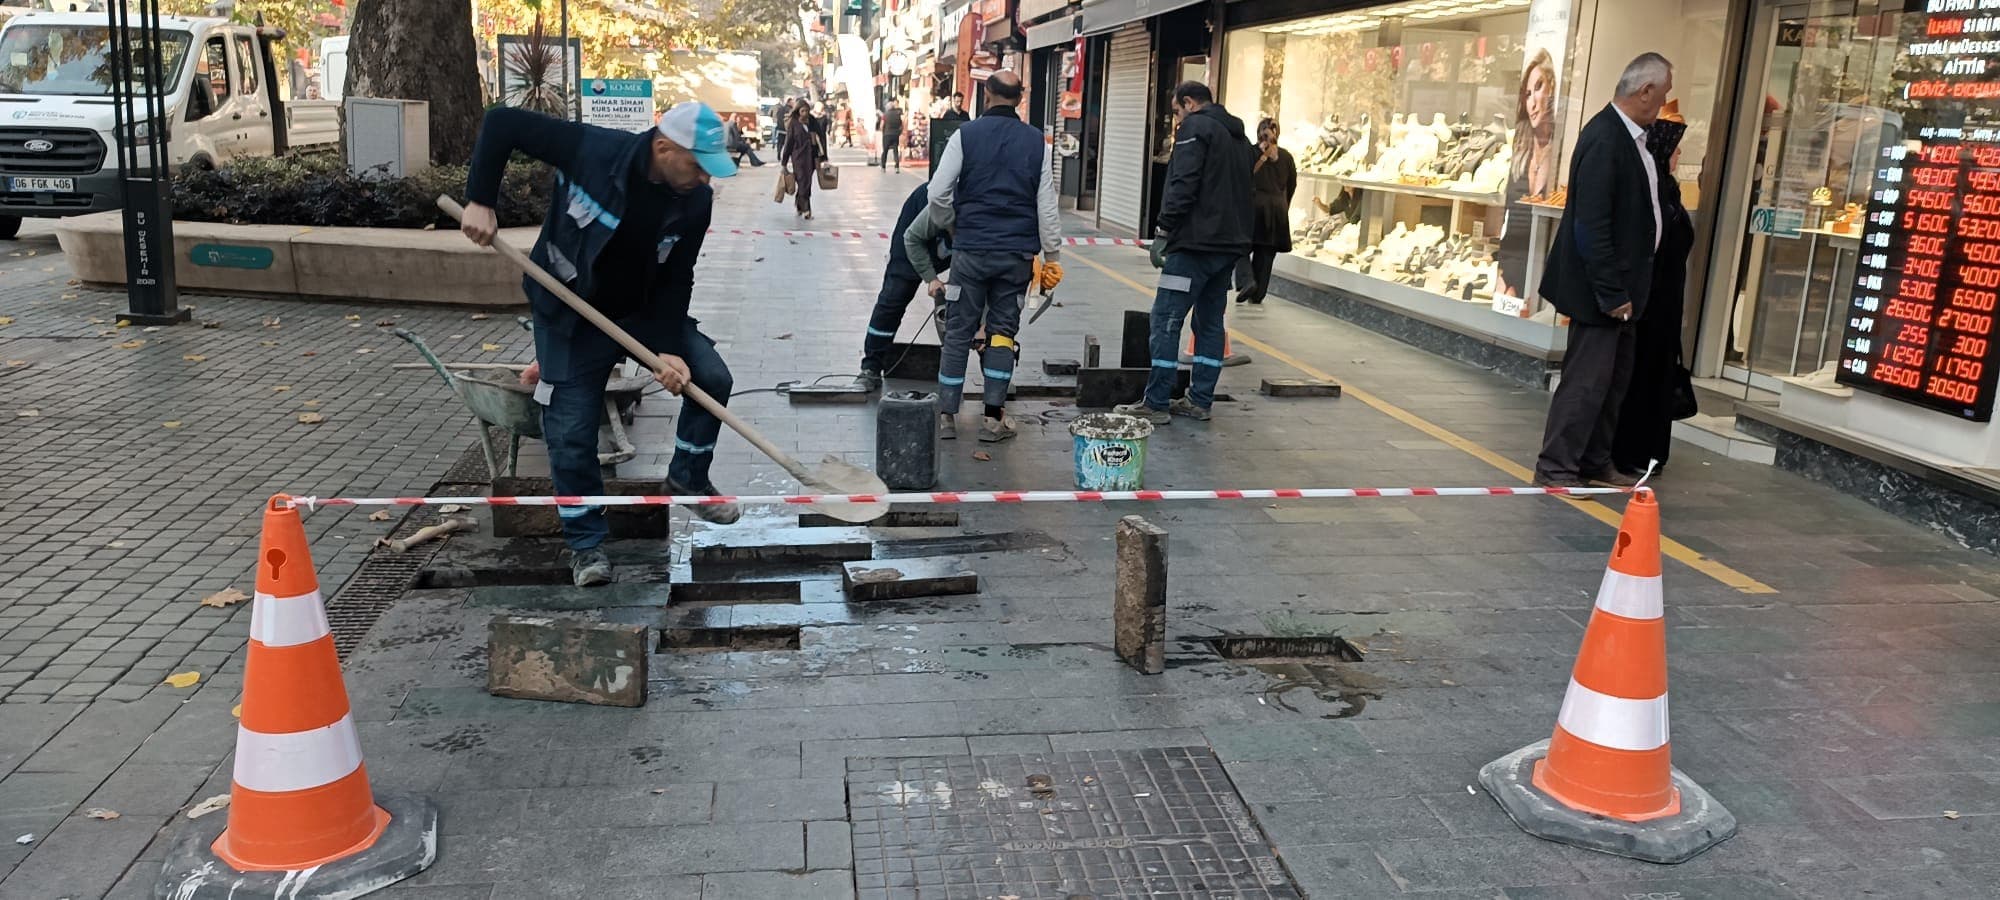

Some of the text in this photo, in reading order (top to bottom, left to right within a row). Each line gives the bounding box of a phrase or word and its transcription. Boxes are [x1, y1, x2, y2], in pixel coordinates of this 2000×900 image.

[1943, 57, 1986, 75] AİTTİR
[15, 178, 71, 189] 06 FGK 406
